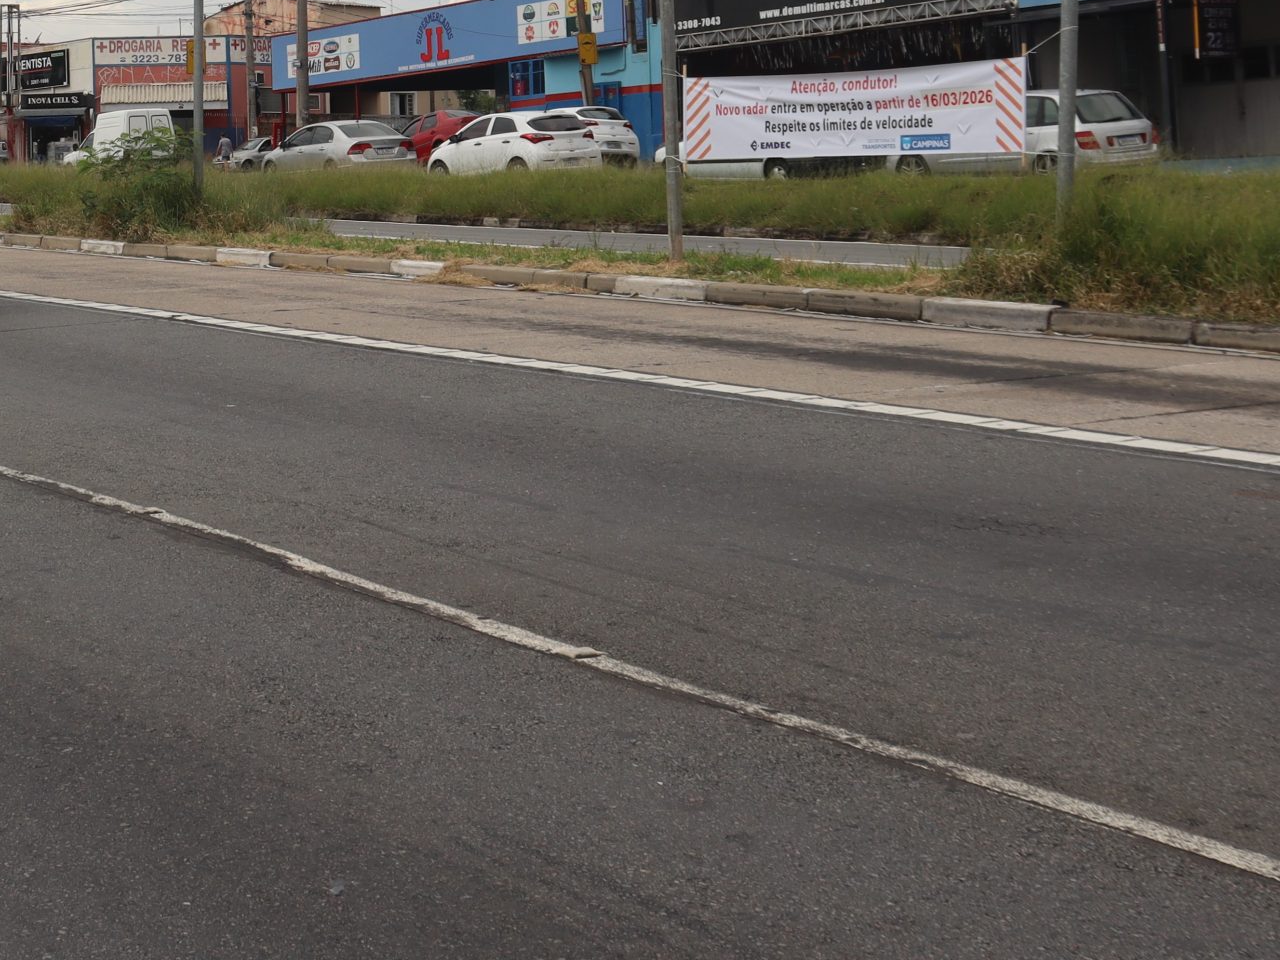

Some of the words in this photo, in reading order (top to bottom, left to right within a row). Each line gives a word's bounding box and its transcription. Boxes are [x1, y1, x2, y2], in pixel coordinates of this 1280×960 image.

[415, 11, 454, 45] SUPERMERCADOS
[677, 16, 721, 30] 3308-7043
[109, 39, 163, 53] DROGARIA
[420, 26, 450, 62] JL
[131, 53, 188, 63] 3223-783
[791, 79, 838, 96] Atenção,
[842, 75, 897, 91] condutor!
[715, 103, 740, 116] Novo
[742, 102, 768, 115] radar
[770, 103, 797, 114] entra
[800, 103, 815, 112] em
[817, 99, 864, 115] operação
[866, 100, 873, 110] a
[875, 96, 904, 112] partir
[907, 95, 921, 108] de
[923, 89, 993, 107] 16/03/2026
[765, 120, 807, 135] Respeite
[809, 121, 820, 132] os
[823, 118, 857, 131] limites
[860, 116, 873, 130] de
[876, 114, 933, 129] velocidade
[760, 141, 791, 149] EMDEC
[911, 138, 949, 149] CAMPINAS
